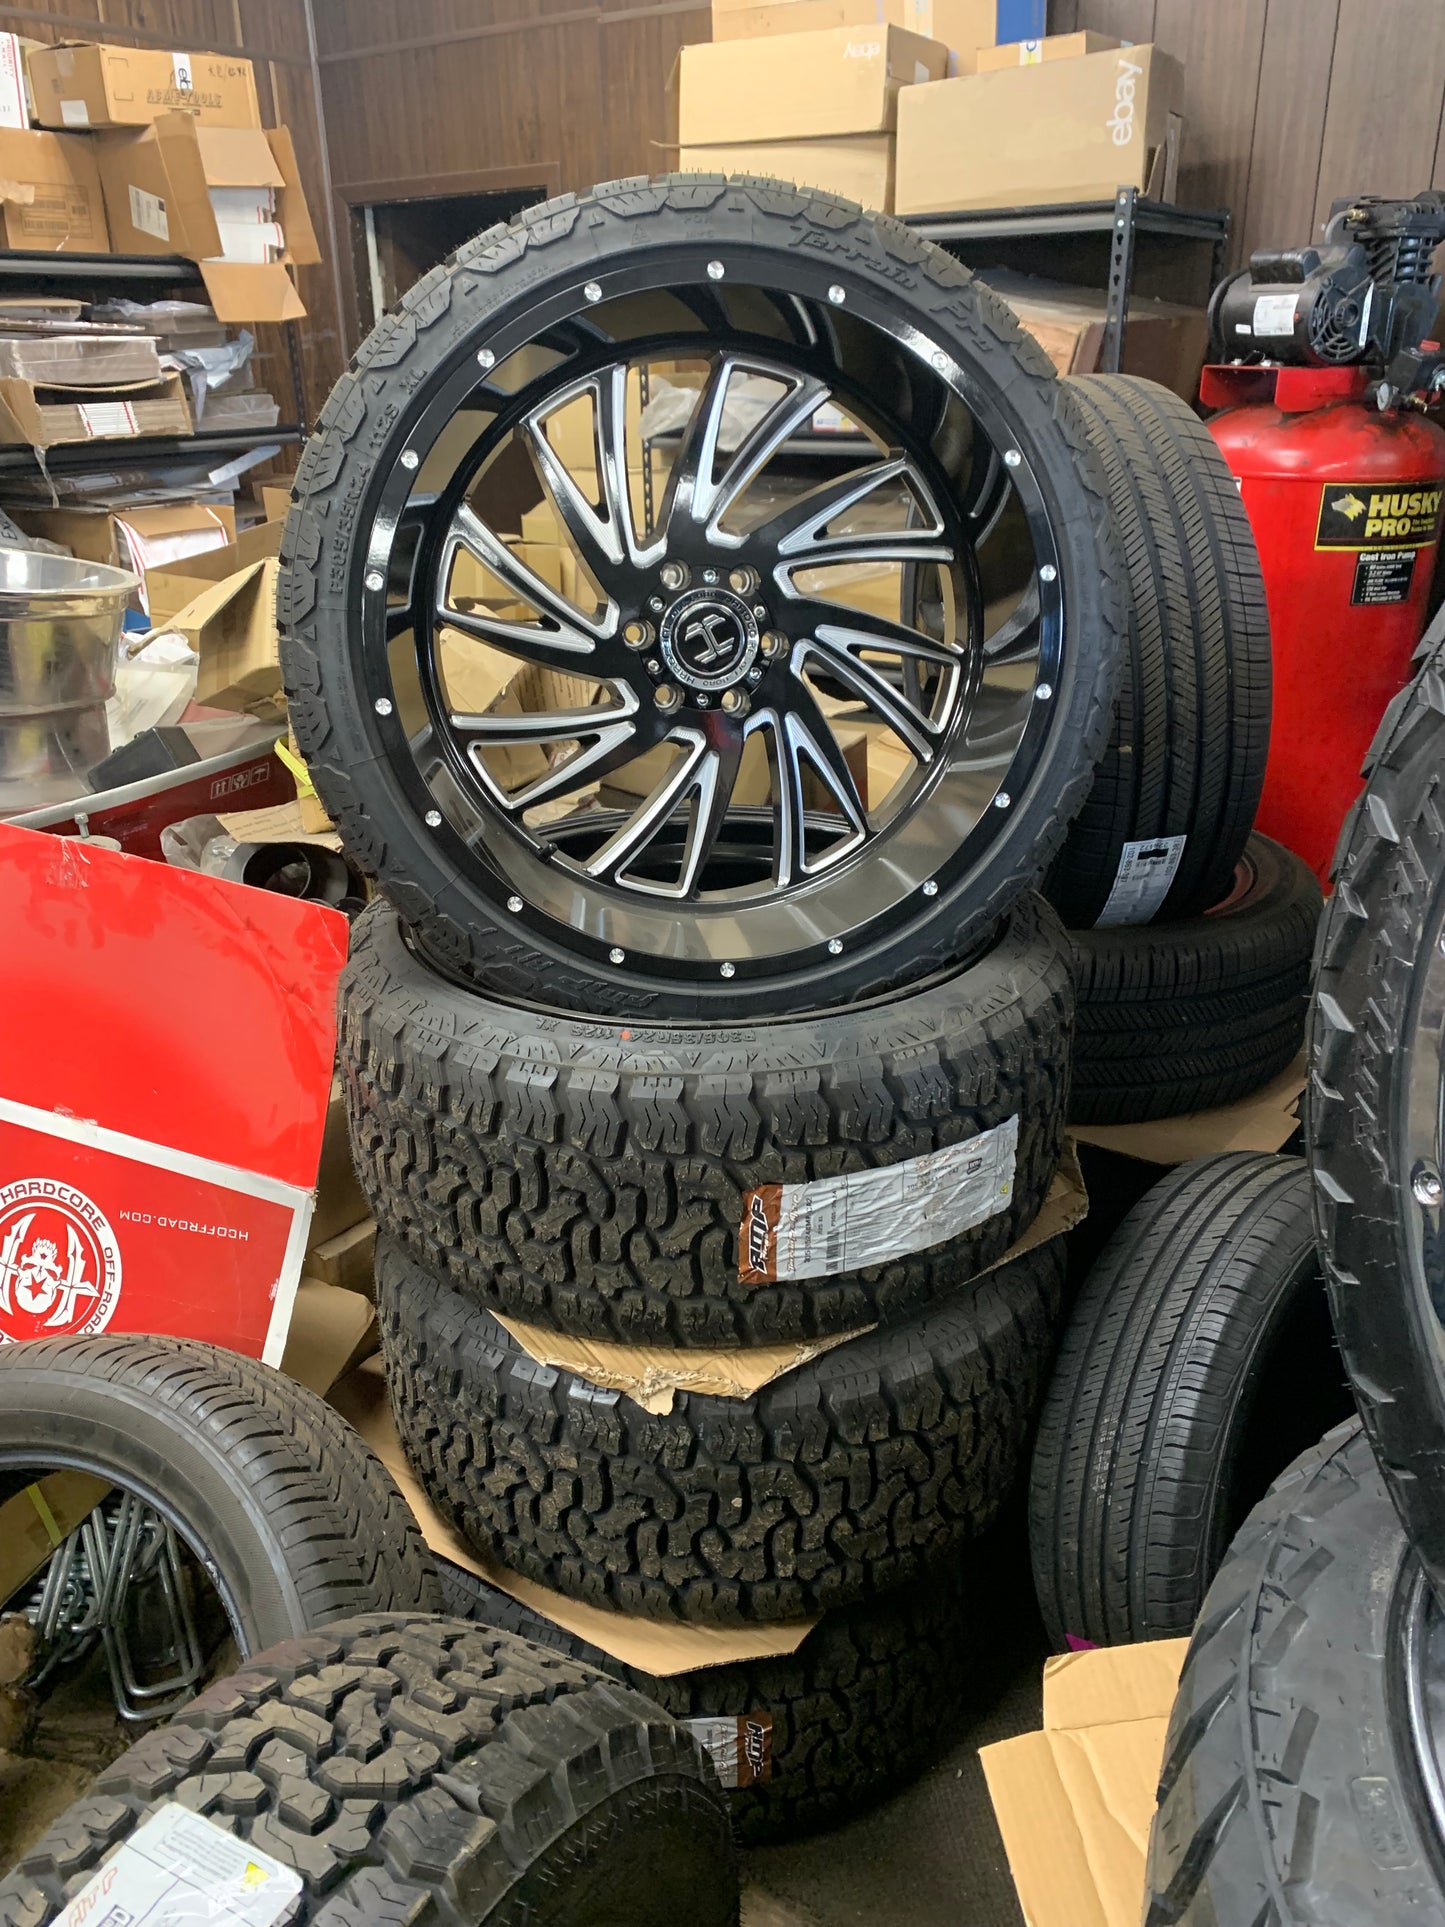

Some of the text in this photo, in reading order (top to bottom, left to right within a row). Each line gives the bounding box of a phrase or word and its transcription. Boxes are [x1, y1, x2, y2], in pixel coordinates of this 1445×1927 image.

[843, 40, 881, 61] ebay
[1106, 59, 1143, 147] ebay
[788, 224, 993, 352] Terrain Pro
[367, 402, 400, 452] 112S
[398, 369, 428, 396] XL
[1368, 492, 1443, 517] HUSKY
[1363, 517, 1411, 538] PRO
[1359, 550, 1417, 562] Cast Iron Pump
[569, 1022, 614, 1040] 112S
[632, 1028, 757, 1044] P305/35R24
[0, 1181, 106, 1232] HARDCORE
[120, 1210, 249, 1242] HCOFFROAD.COM
[750, 1195, 768, 1275] AMP
[745, 1720, 764, 1777] AMP
